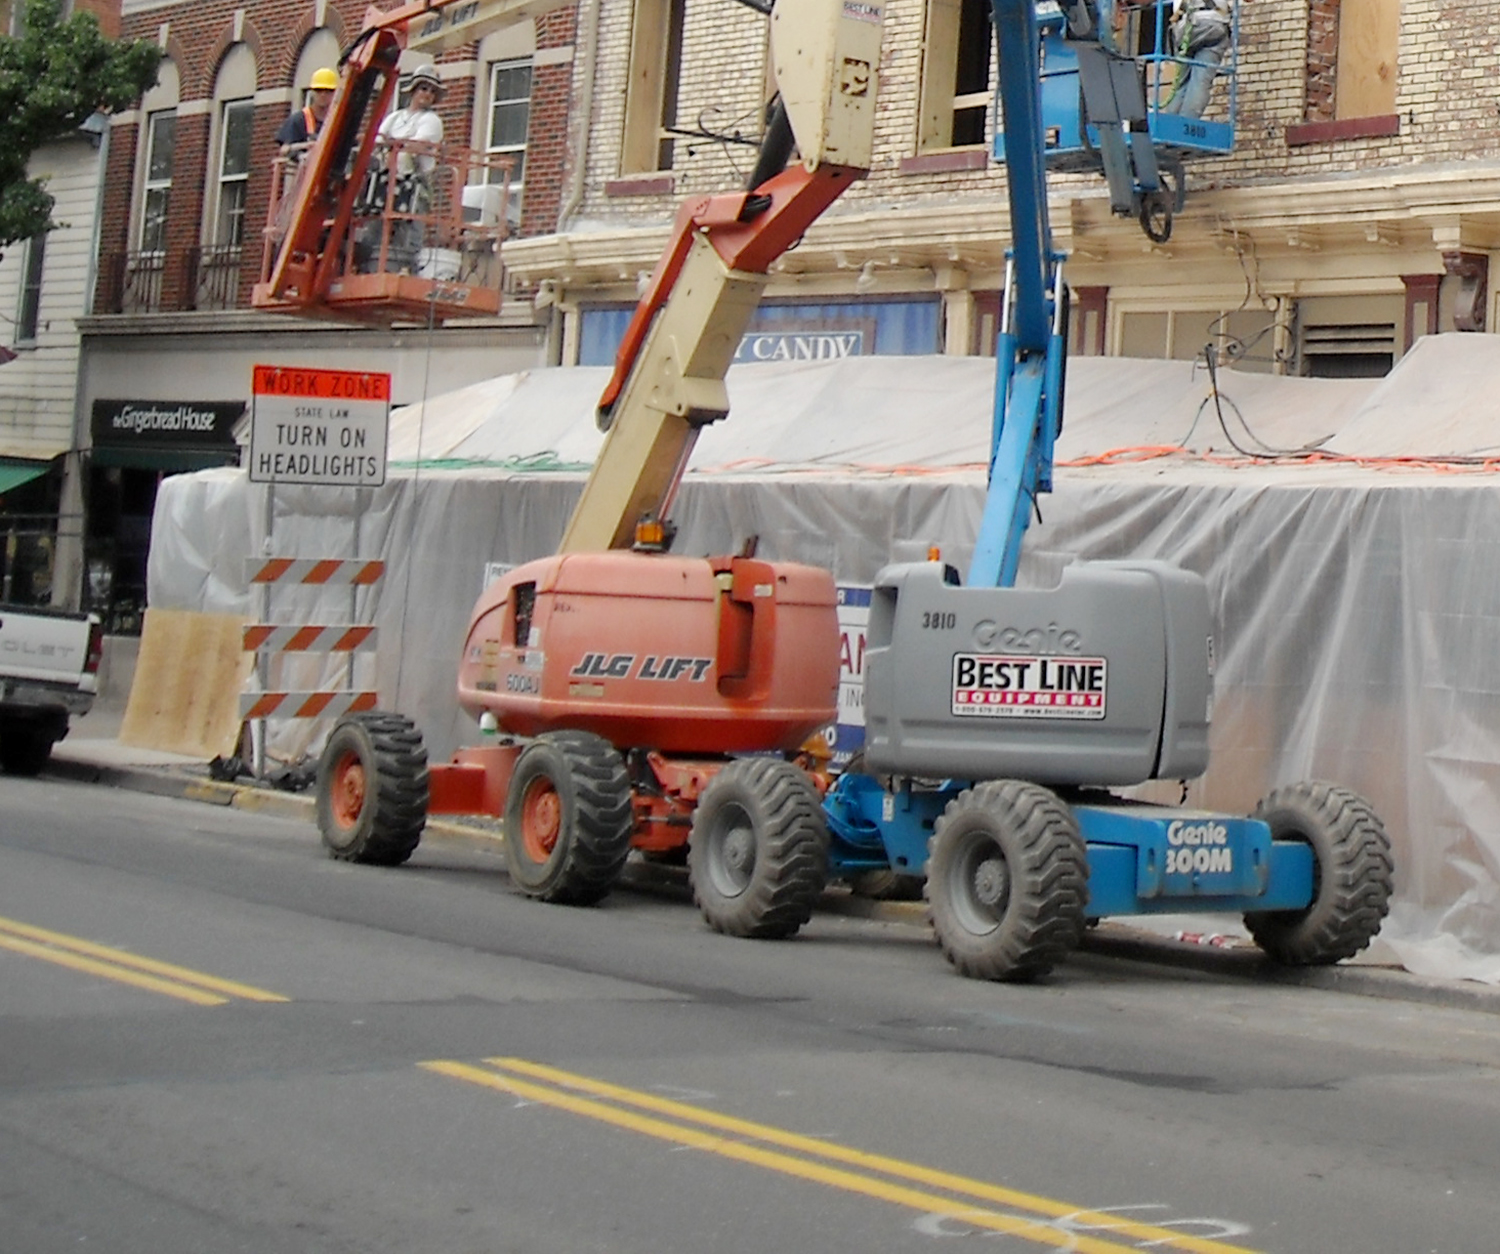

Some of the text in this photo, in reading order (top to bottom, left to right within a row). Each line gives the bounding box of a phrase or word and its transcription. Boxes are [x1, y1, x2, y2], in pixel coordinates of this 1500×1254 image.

[451, 1, 480, 25] LIFT
[753, 335, 857, 360] CANDY
[264, 371, 382, 399] WORK ZONE
[182, 406, 216, 431] House
[294, 407, 349, 419] STATE LAW
[277, 424, 366, 448] TURN ON
[260, 453, 377, 477] HEADLIGHTS
[922, 612, 956, 630] 3810
[972, 619, 1083, 655] Genie
[570, 652, 715, 683] JLG LIFT
[957, 657, 1103, 692] BEST LINE
[957, 691, 1102, 706] EQUIPMENT
[1166, 819, 1227, 846] Genie
